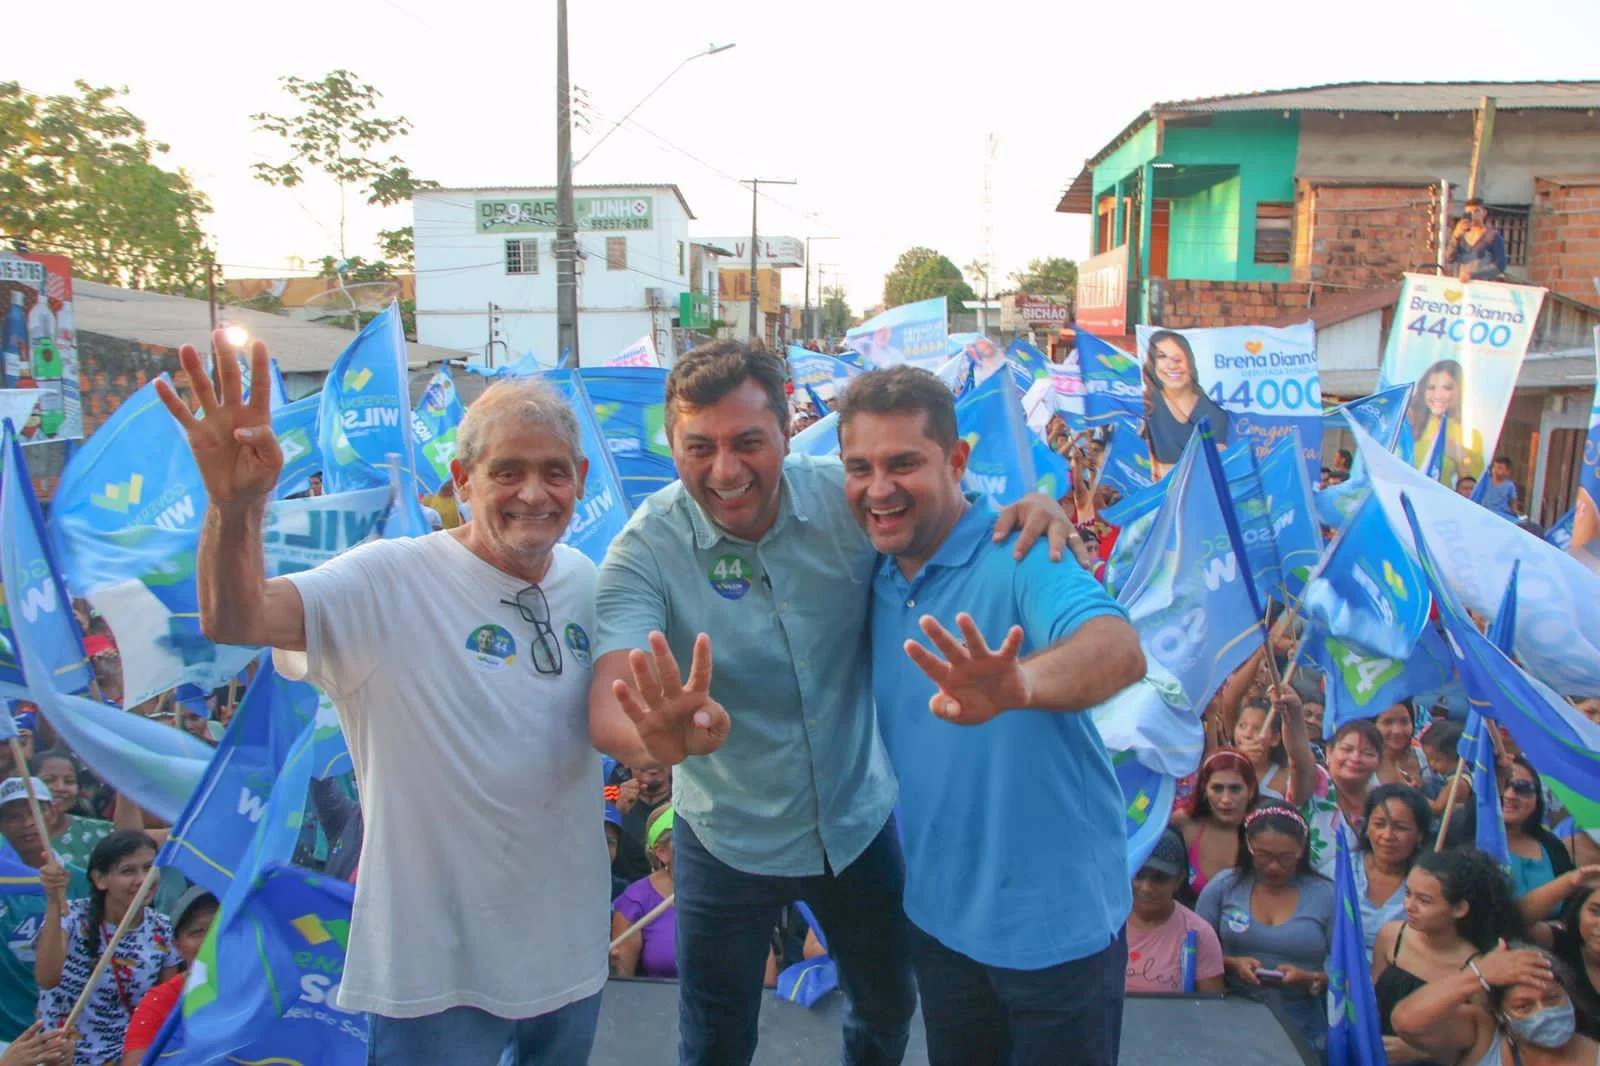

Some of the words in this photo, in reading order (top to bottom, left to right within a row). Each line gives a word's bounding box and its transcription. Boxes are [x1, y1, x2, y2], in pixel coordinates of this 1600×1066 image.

[1410, 296, 1462, 316] Brena
[1407, 314, 1512, 348] 44000
[1214, 352, 1267, 369] Brena
[1208, 378, 1321, 410] 44000
[713, 558, 743, 579] 44
